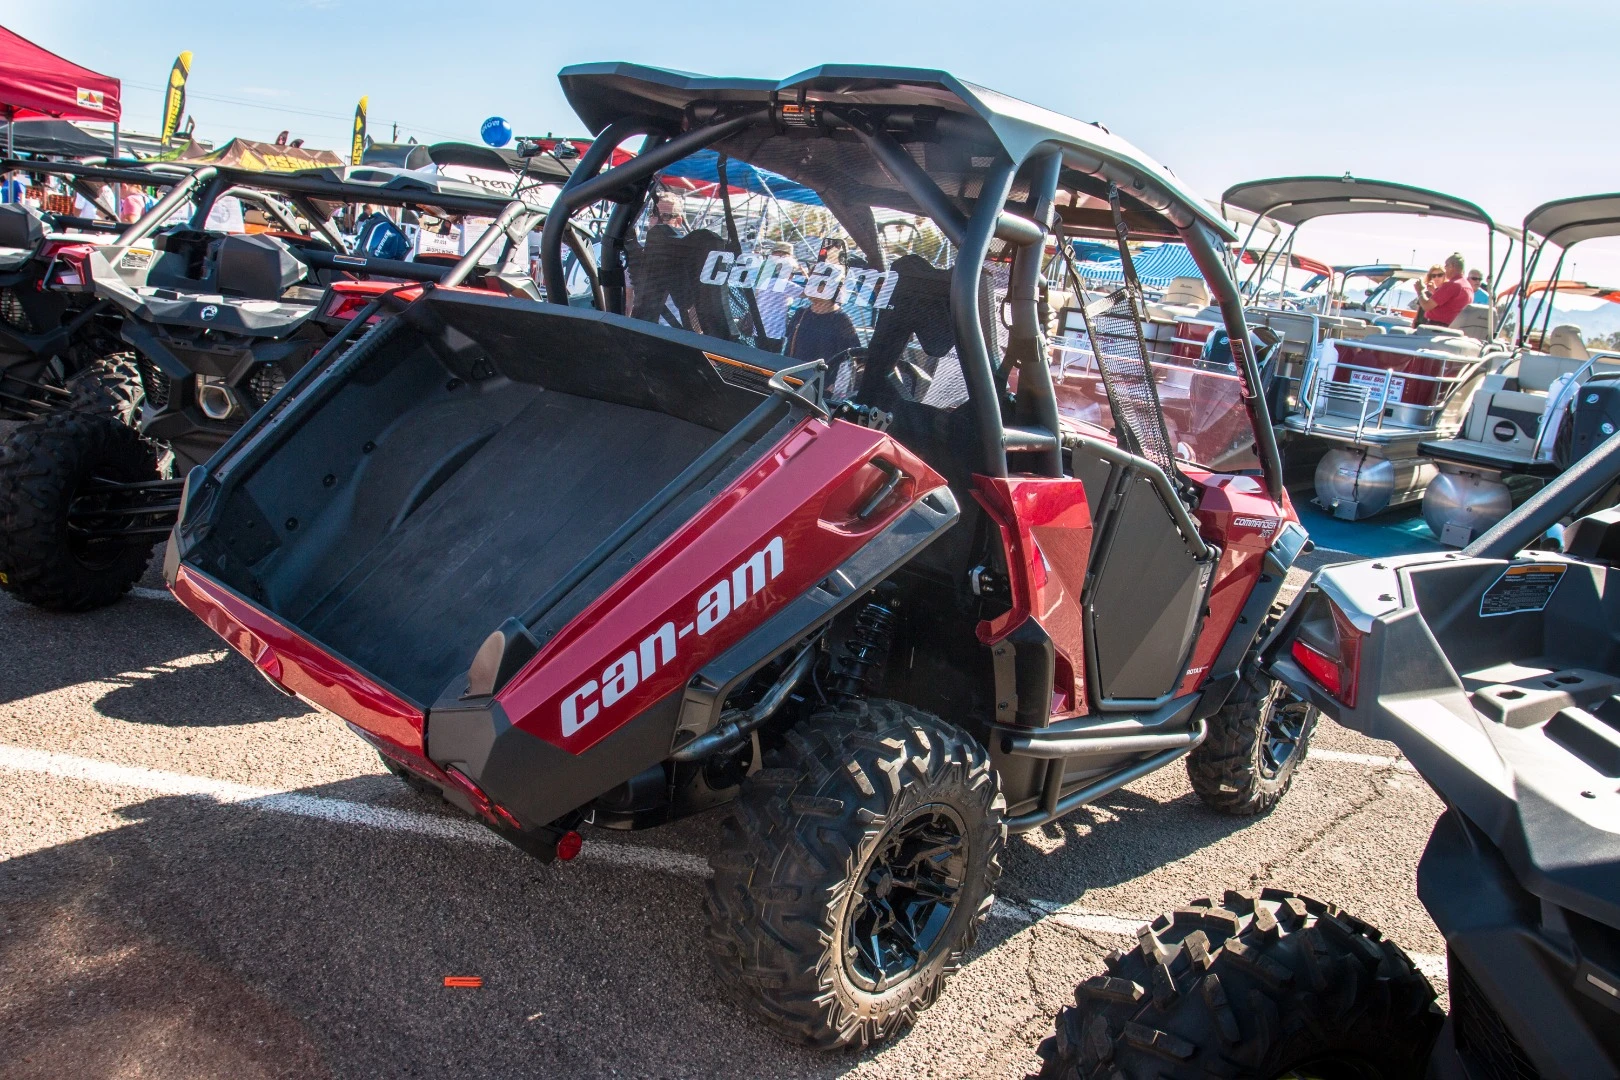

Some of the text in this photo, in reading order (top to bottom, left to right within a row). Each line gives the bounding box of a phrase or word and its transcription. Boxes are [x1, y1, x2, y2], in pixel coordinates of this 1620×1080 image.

[467, 174, 542, 195] Premr
[700, 250, 899, 309] can-am
[1233, 517, 1277, 529] COMMANDER
[560, 536, 784, 738] can-am
